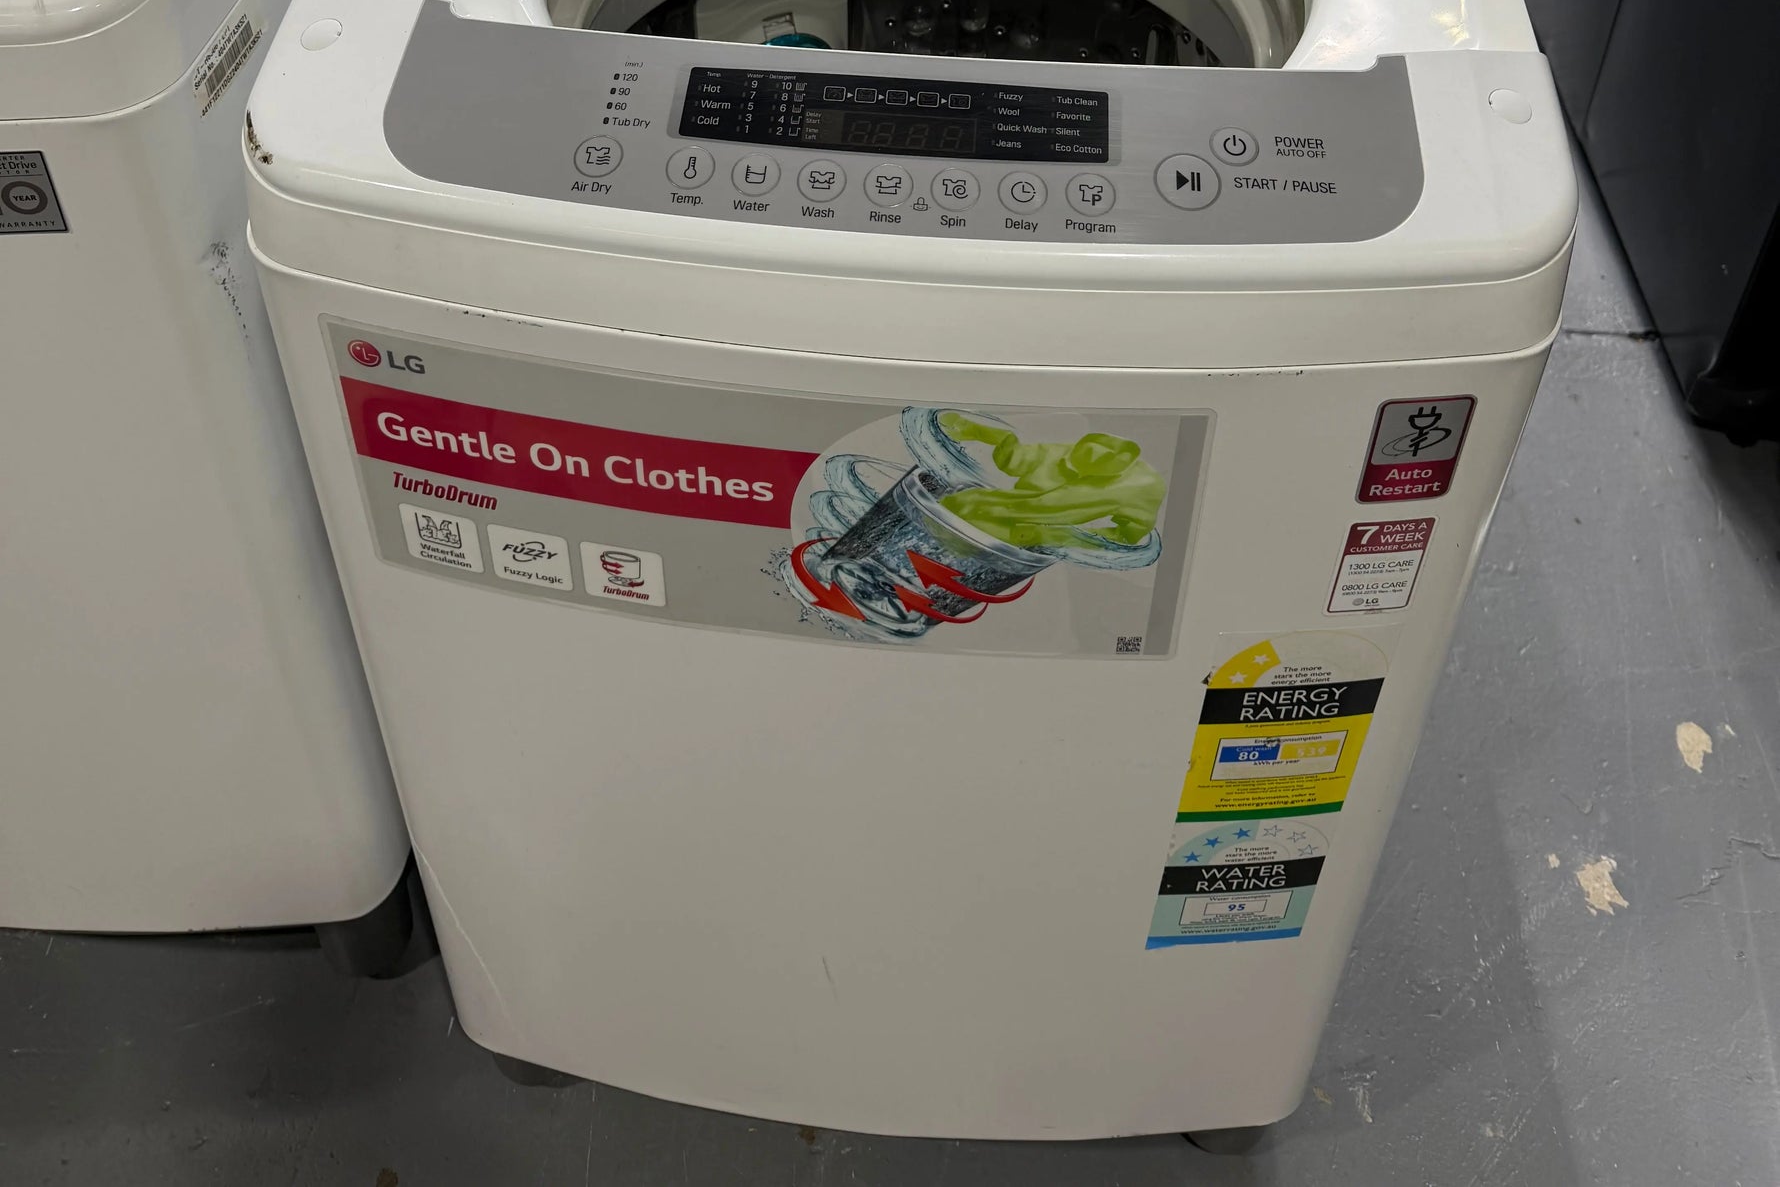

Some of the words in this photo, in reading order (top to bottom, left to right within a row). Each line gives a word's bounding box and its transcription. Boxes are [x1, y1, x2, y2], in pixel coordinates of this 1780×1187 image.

[622, 73, 639, 82] 120
[703, 84, 721, 94] Hot
[751, 80, 758, 89] 9
[781, 82, 793, 91] 10
[618, 87, 631, 96] 90
[750, 91, 757, 100] 7
[998, 92, 1024, 102] Fuzzy
[781, 93, 789, 102] 8
[1057, 95, 1072, 105] Tub
[1074, 97, 1098, 106] Clean
[614, 102, 627, 111] 60
[701, 99, 731, 110] Warm
[747, 102, 754, 111] 5
[779, 104, 787, 113] 6
[998, 107, 1020, 116] Wool
[1056, 111, 1091, 122] Favorite
[612, 116, 631, 127] Tub
[632, 118, 651, 129] Dry
[697, 115, 719, 125] Cold
[745, 114, 752, 122] 3
[778, 115, 785, 124] 4
[744, 125, 750, 133] 1
[776, 127, 783, 136] 2
[997, 123, 1021, 132] Quick
[1022, 124, 1047, 134] Wash
[1055, 127, 1080, 137] Silent
[996, 139, 1022, 149] Jeans
[1055, 143, 1071, 153] Eco
[1073, 144, 1102, 154] Cotton
[1274, 136, 1325, 150] POWER
[1276, 148, 1304, 158] AUTO
[1306, 150, 1327, 159] OFF
[8, 161, 37, 170] Drive
[571, 181, 589, 192] Air
[591, 181, 612, 194] Dry
[1234, 176, 1278, 191] START
[1283, 180, 1289, 191] /
[1292, 181, 1337, 194] PAUSE
[12, 194, 37, 202] YEAR
[670, 192, 704, 206] Temp.
[733, 200, 770, 212] Water
[801, 206, 835, 218] Wash
[869, 211, 902, 224] Rinse
[940, 214, 966, 228] Spin
[1004, 218, 1039, 233] Delay
[1065, 219, 1117, 235] Program
[386, 350, 426, 374] LG
[377, 411, 516, 465] Gentle
[529, 443, 591, 478] On
[604, 454, 775, 503] Clothes
[1385, 468, 1432, 481] Auto
[393, 471, 498, 511] TurboDrum
[1369, 481, 1441, 496] Restart
[1357, 526, 1380, 545] 7
[1383, 522, 1415, 532] DAYS
[1380, 531, 1426, 543] WEEK
[420, 542, 466, 560] Waterfall
[502, 543, 558, 560] FUZZY
[1350, 545, 1399, 553] CUSTOMER
[1400, 542, 1424, 550] CARE
[420, 551, 472, 569] Circulation
[1348, 563, 1371, 571] 1300
[1388, 559, 1414, 568] CARE
[504, 566, 533, 579] Fuzzy
[536, 572, 564, 584] Logic
[1341, 584, 1364, 592] 0800
[1381, 580, 1408, 589] CARE
[602, 585, 650, 601] TurboDrum
[1242, 686, 1348, 706] ENERGY
[1240, 702, 1340, 722] RATING
[1238, 751, 1259, 760] 80
[1201, 864, 1286, 879] WATER
[1195, 876, 1287, 892] RATING
[1227, 903, 1246, 911] 95
